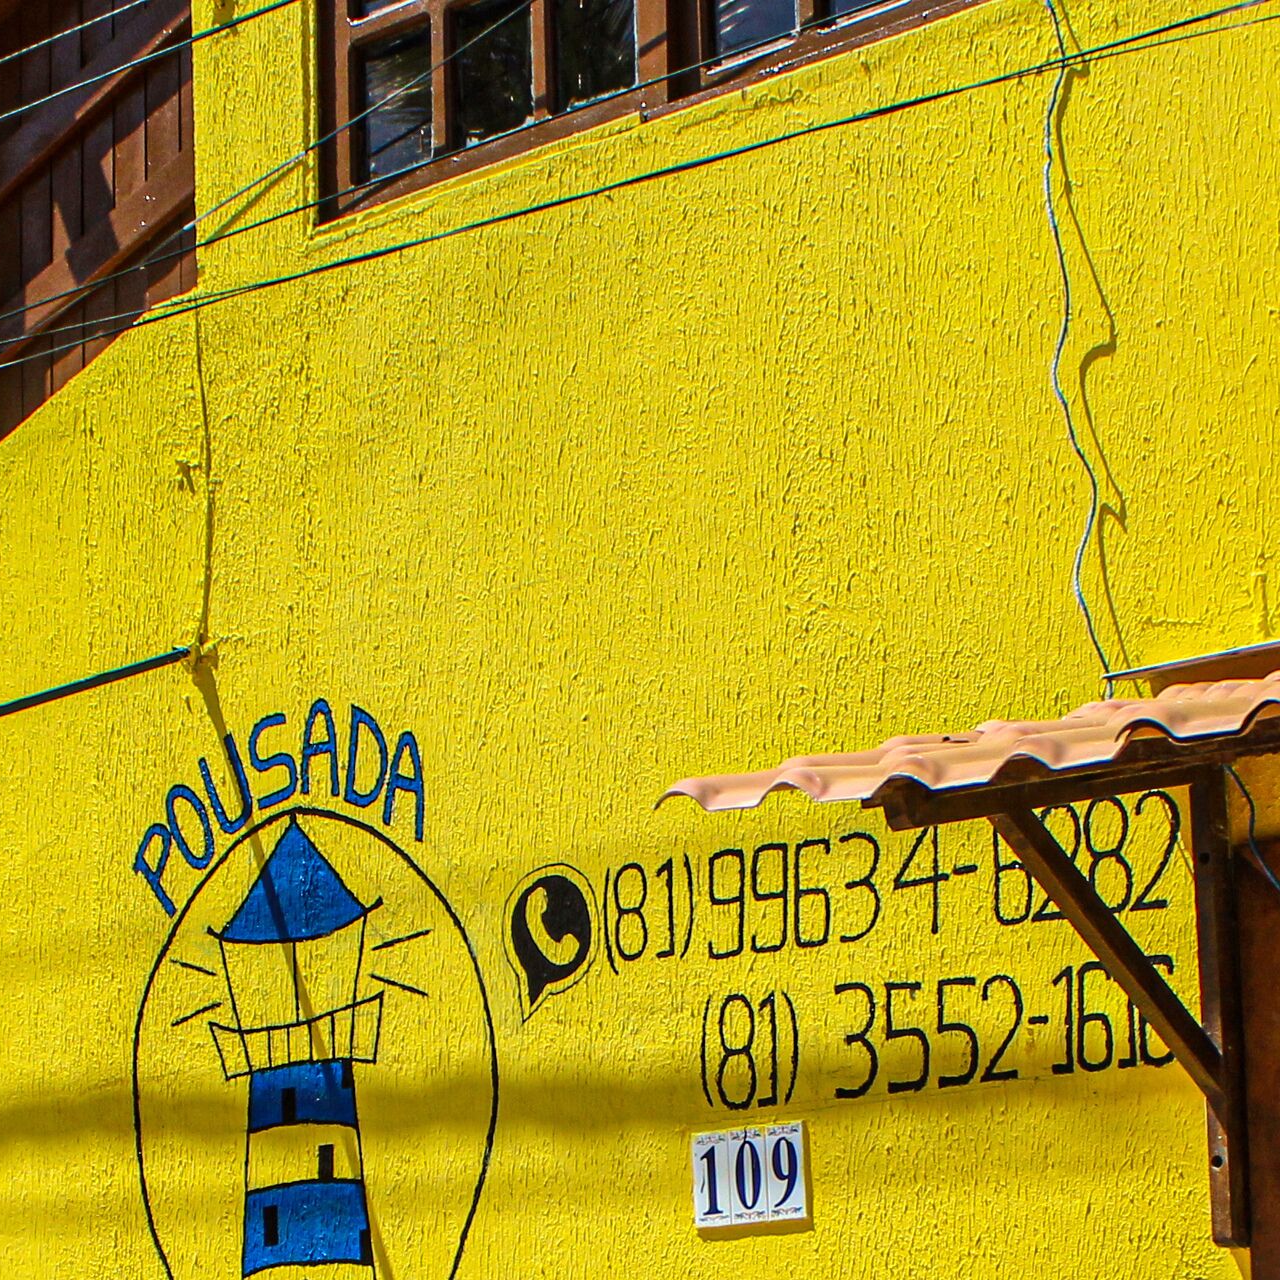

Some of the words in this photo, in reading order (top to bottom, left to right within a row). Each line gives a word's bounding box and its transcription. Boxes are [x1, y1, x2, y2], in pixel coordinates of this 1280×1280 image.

[132, 698, 425, 918] POUSADA
[700, 990, 799, 1111] (81)
[700, 1136, 798, 1216] 109
